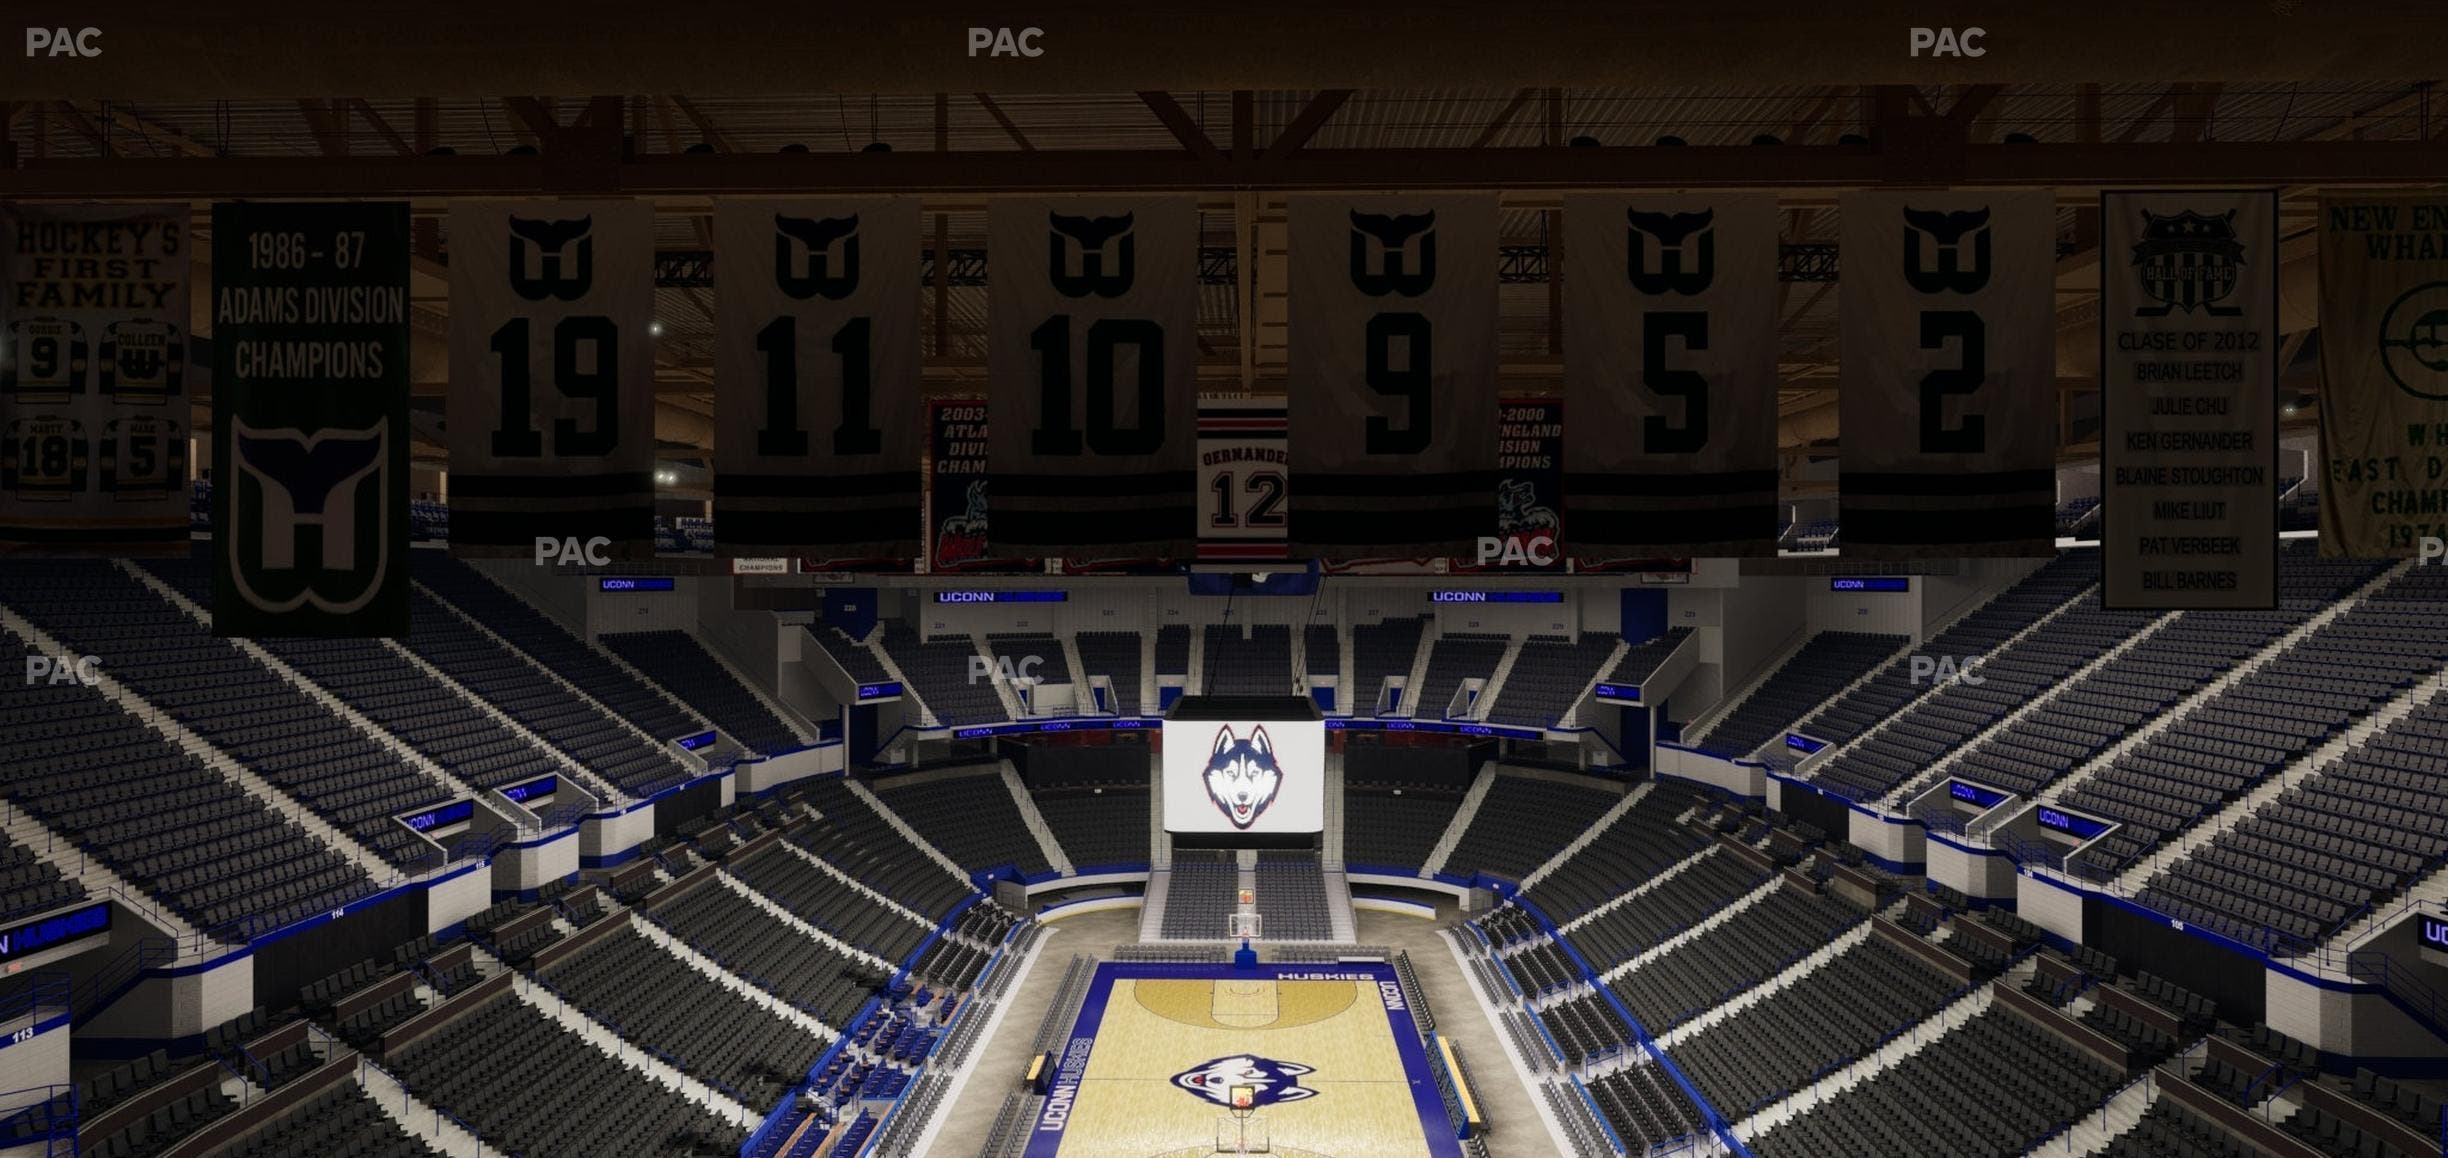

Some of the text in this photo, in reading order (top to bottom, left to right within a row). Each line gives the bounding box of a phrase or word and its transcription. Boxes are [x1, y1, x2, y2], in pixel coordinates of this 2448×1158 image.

[2327, 205, 2400, 232] NEW
[16, 221, 180, 255] HOCKEY'S
[249, 231, 306, 270] 1986
[335, 231, 367, 270] 87
[34, 258, 160, 279] FIRST
[16, 282, 176, 309] FAMILY
[218, 286, 405, 325] ADAMS DIVISION
[2183, 332, 2209, 350] OF
[2214, 332, 2259, 350] 2012
[31, 336, 58, 377] 9
[234, 340, 385, 379] CHAMPIONS
[1031, 315, 1164, 455] 10
[1366, 312, 1431, 455] 9
[1643, 311, 1708, 453] 5
[1920, 310, 1985, 453] 2
[2137, 363, 2242, 381] BRIAN LEETCH
[490, 316, 618, 457] 19
[757, 317, 881, 455] 11
[2152, 397, 2228, 415] JULIE CHU
[2127, 432, 2254, 450] KEN GERNANDER
[22, 435, 68, 477] 18
[130, 436, 157, 476] 5
[2332, 456, 2399, 482] EAST
[2116, 467, 2264, 485] BLAINE STOUGHTON
[1211, 471, 1287, 528] 12
[2154, 502, 2226, 519] MIKE LIUT
[2140, 537, 2240, 554] PAT VERBEEK
[602, 579, 635, 589] UCONN
[1834, 579, 1864, 589] UCONN
[2143, 572, 2238, 590] BILL BARNES
[940, 592, 994, 602] UCONN
[1433, 591, 1486, 601] UCONN
[2040, 807, 2069, 830] UCONN
[12, 1027, 34, 1043] 113
[1040, 1038, 1093, 1131] UCONN HUSKIES
